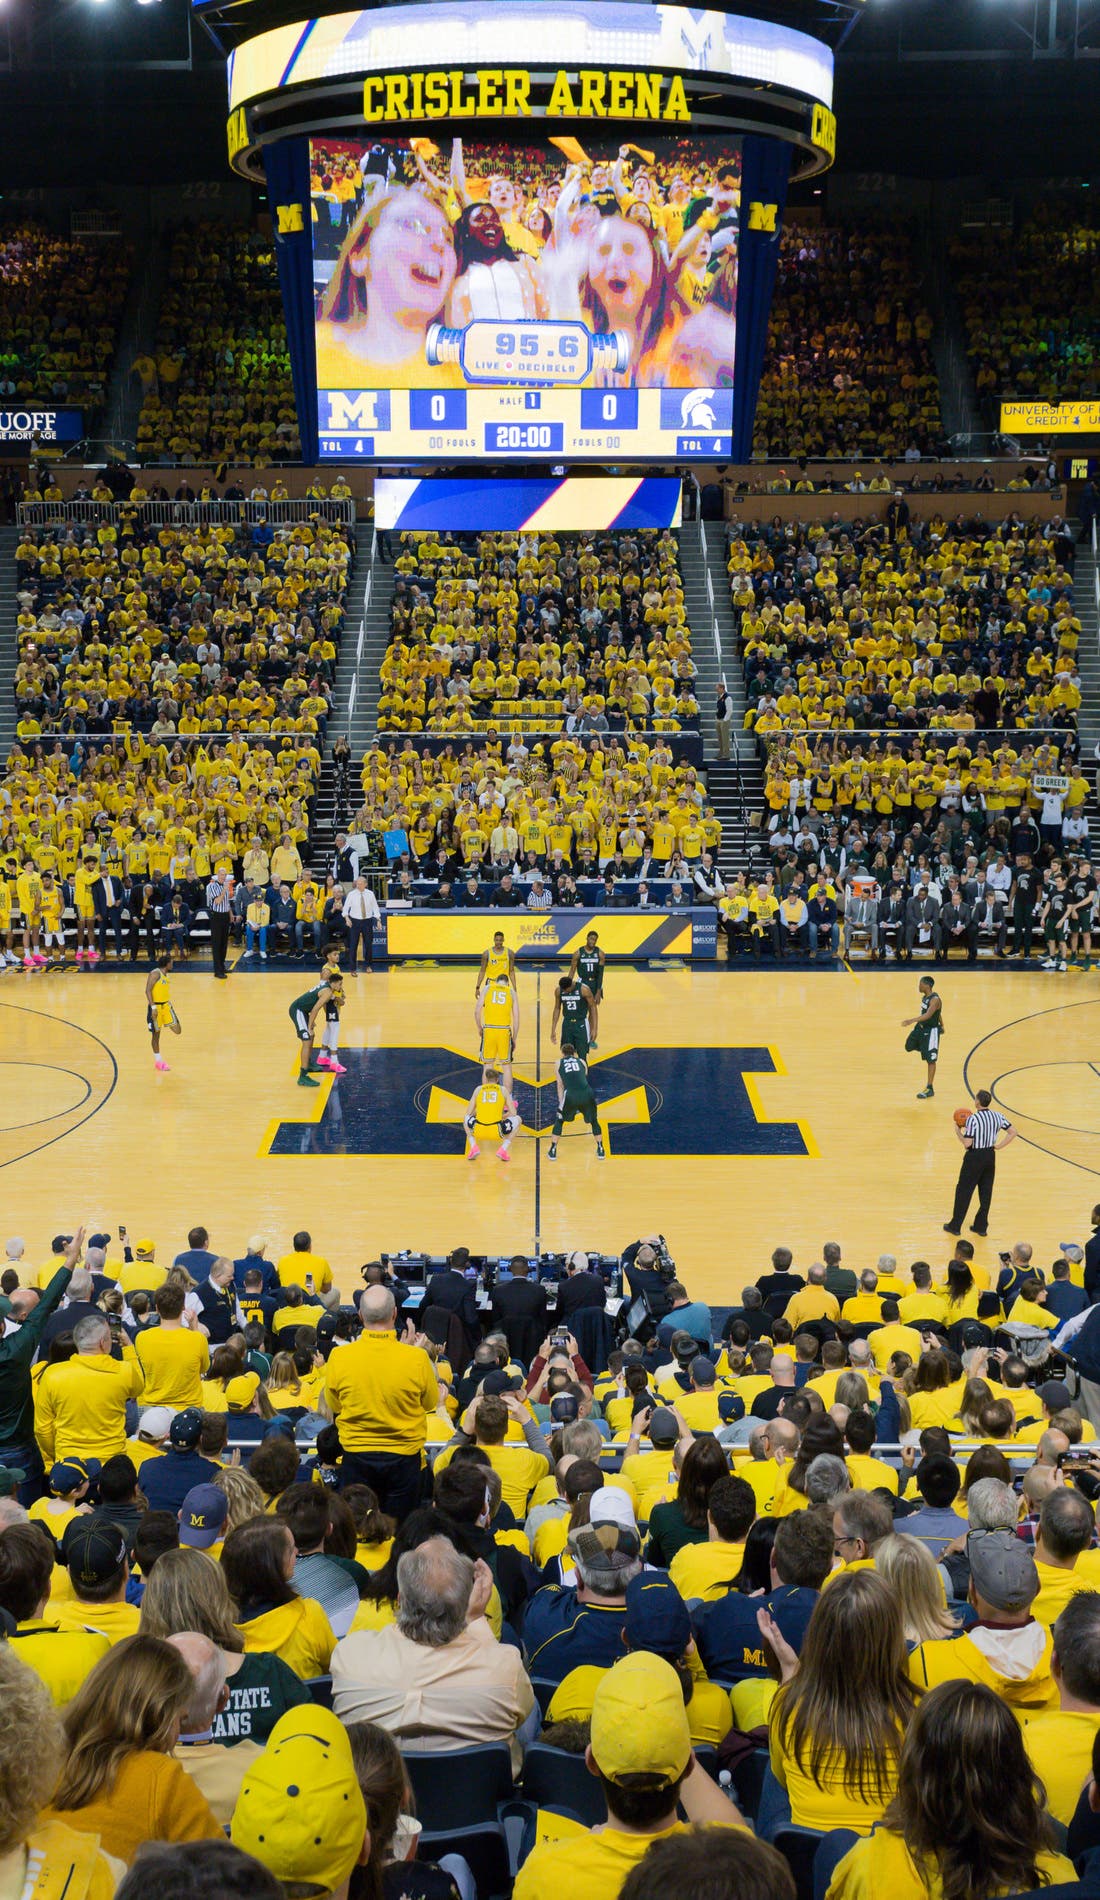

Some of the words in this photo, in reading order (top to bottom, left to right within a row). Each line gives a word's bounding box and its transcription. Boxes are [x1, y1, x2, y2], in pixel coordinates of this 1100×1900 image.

[363, 69, 532, 122] CRISLER
[546, 70, 692, 121] ARENA
[277, 203, 304, 234] M
[747, 202, 778, 232] M
[475, 361, 500, 369] LIVE
[530, 394, 536, 407] 1
[328, 392, 378, 429] M
[431, 395, 445, 421] 0
[602, 395, 617, 420] 0
[1004, 405, 1075, 415] UNIVERSITY
[1079, 405, 1095, 413] OF
[1026, 416, 1069, 425] CREDIT
[446, 438, 476, 447] FOULS
[496, 426, 551, 448] 20:00
[572, 438, 602, 446] FOULS
[322, 442, 342, 451] TOL
[355, 440, 363, 453] 4
[682, 441, 702, 450] TOL
[713, 439, 722, 452] 4
[1035, 777, 1045, 786] GO
[1045, 778, 1067, 787] GREEN
[586, 963, 594, 972] 11
[491, 990, 507, 1004] 15
[566, 1001, 577, 1010] 23
[563, 1062, 580, 1073] 20
[481, 1091, 497, 1103] 13
[240, 1300, 260, 1309] BRADY
[190, 1513, 205, 1527] M
